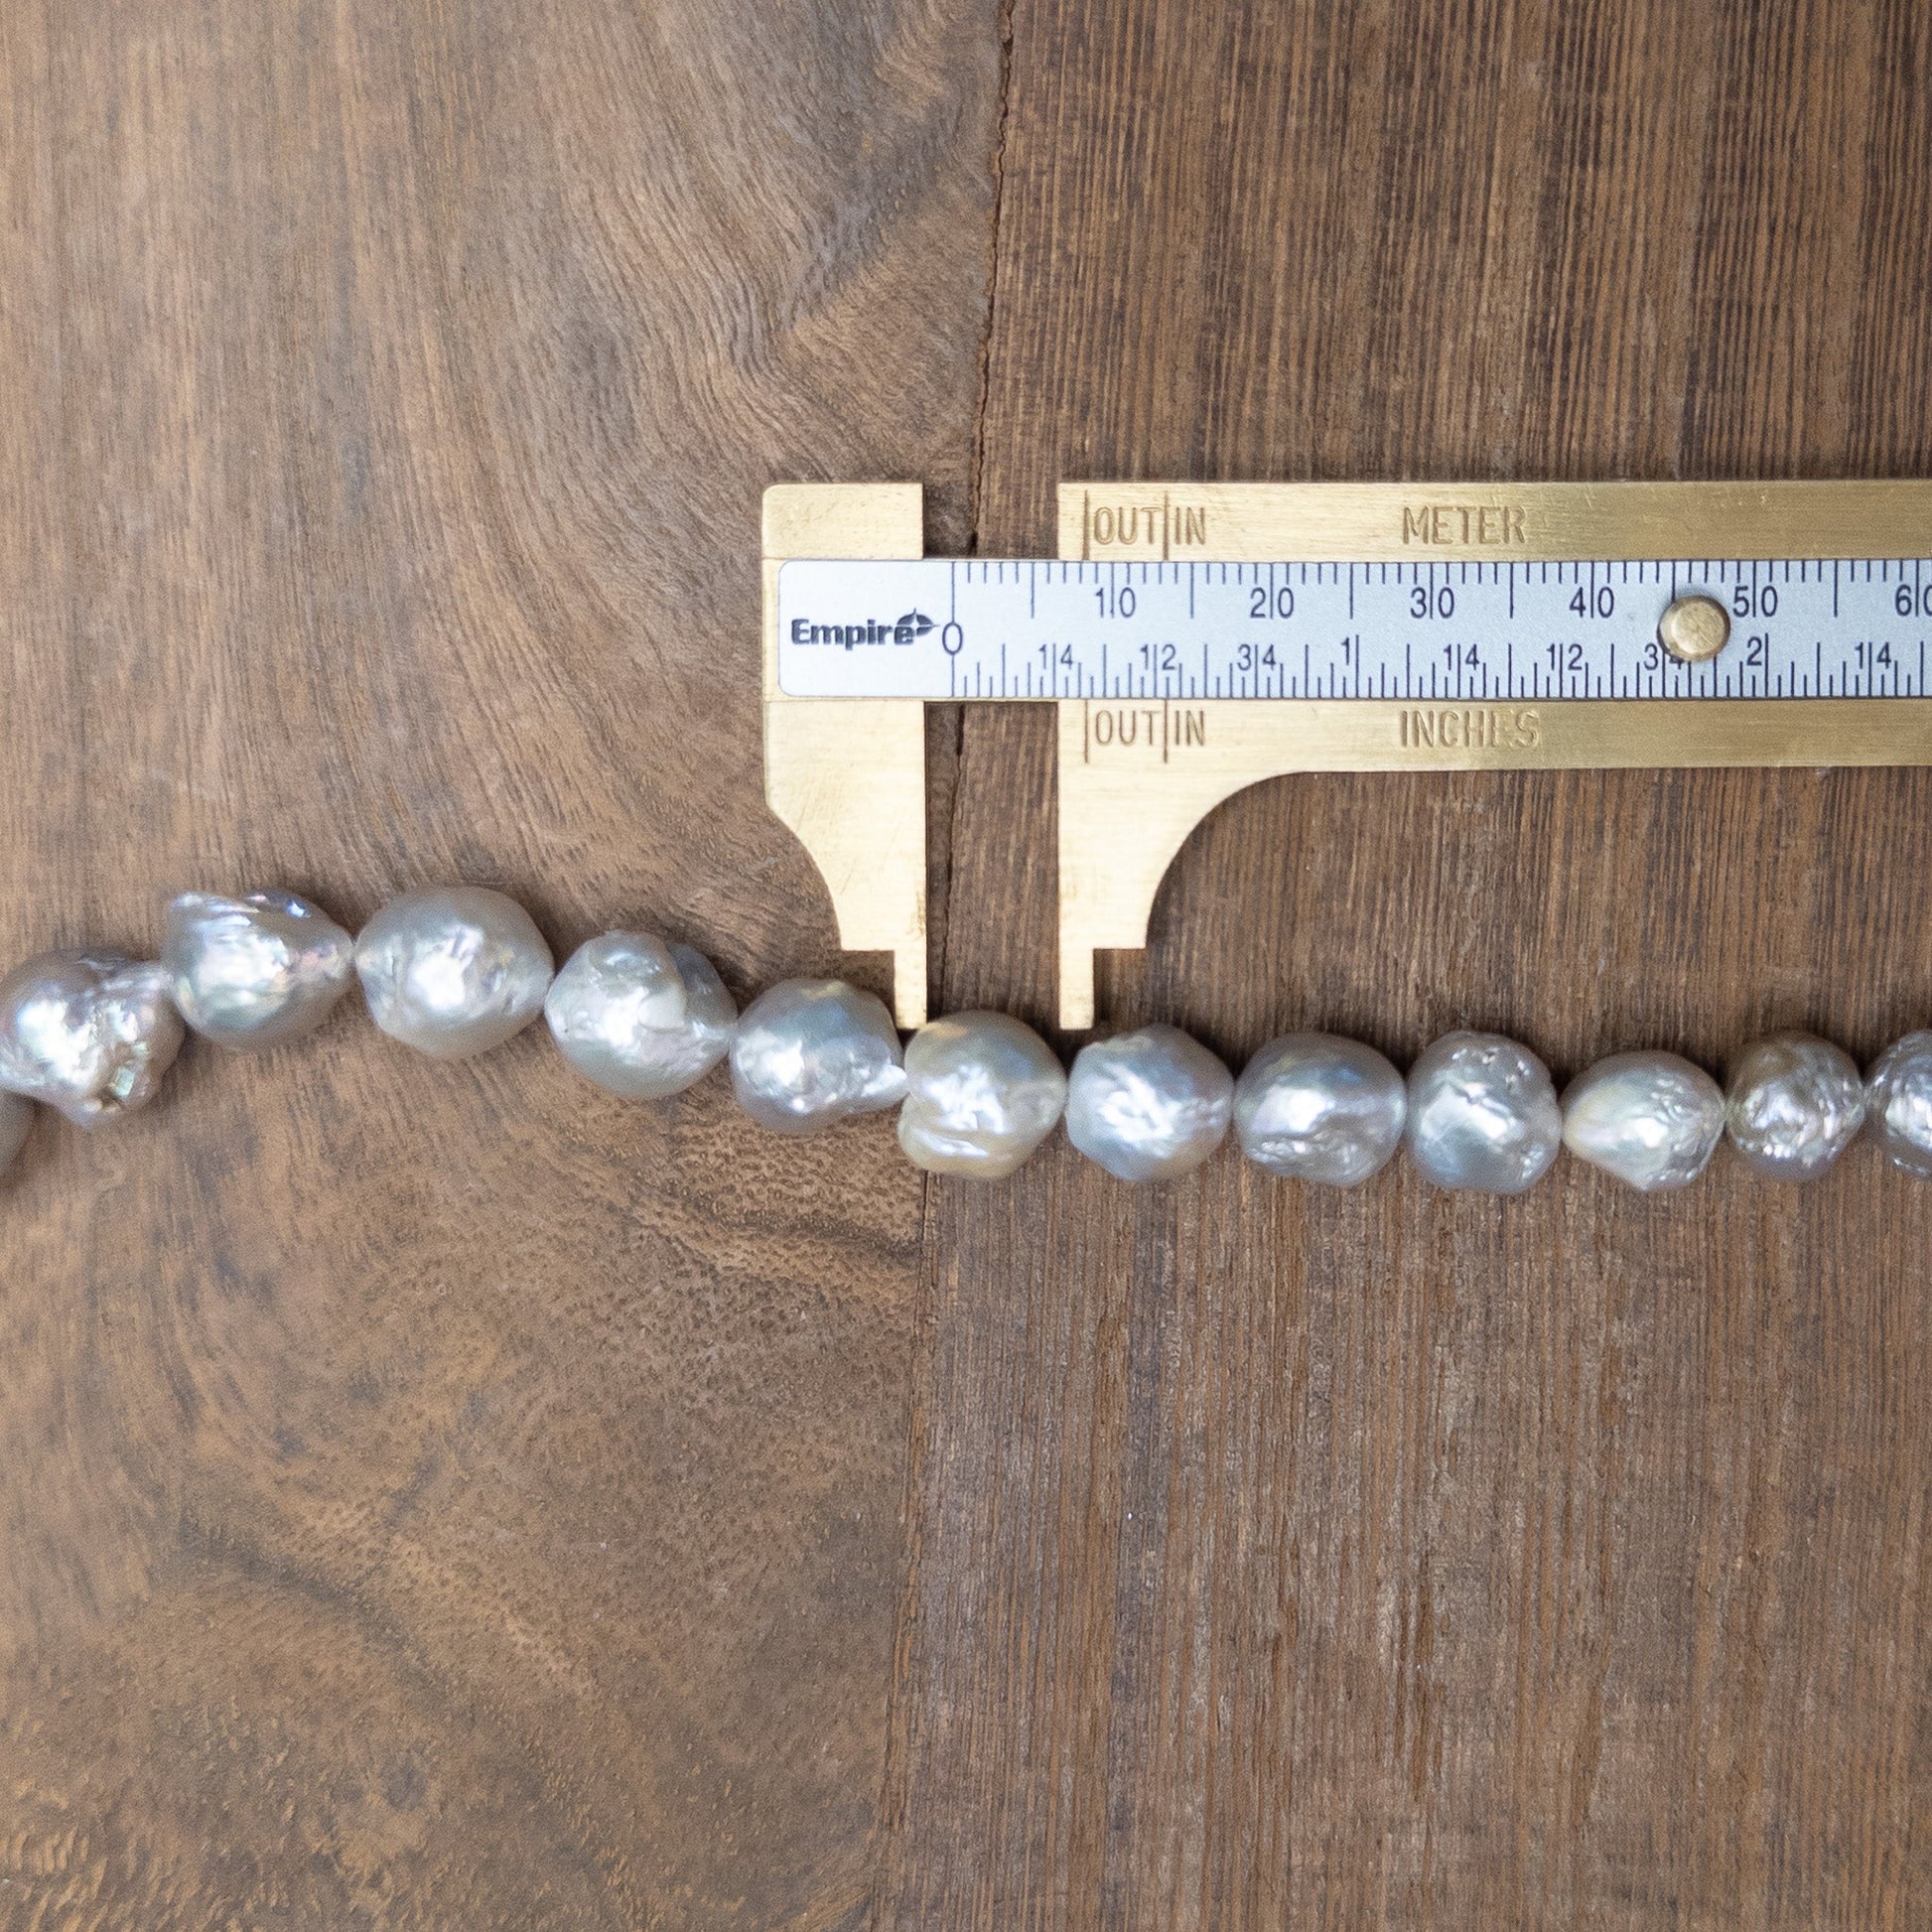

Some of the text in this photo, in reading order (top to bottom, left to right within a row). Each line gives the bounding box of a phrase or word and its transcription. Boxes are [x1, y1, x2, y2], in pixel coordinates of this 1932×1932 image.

[1093, 506, 1163, 545] OUT
[1402, 505, 1526, 545] METER
[790, 618, 914, 651] Empire
[942, 621, 963, 655] 0
[1746, 636, 1763, 667] 2
[1094, 710, 1162, 746] OUT
[1399, 709, 1539, 747] INCHES
